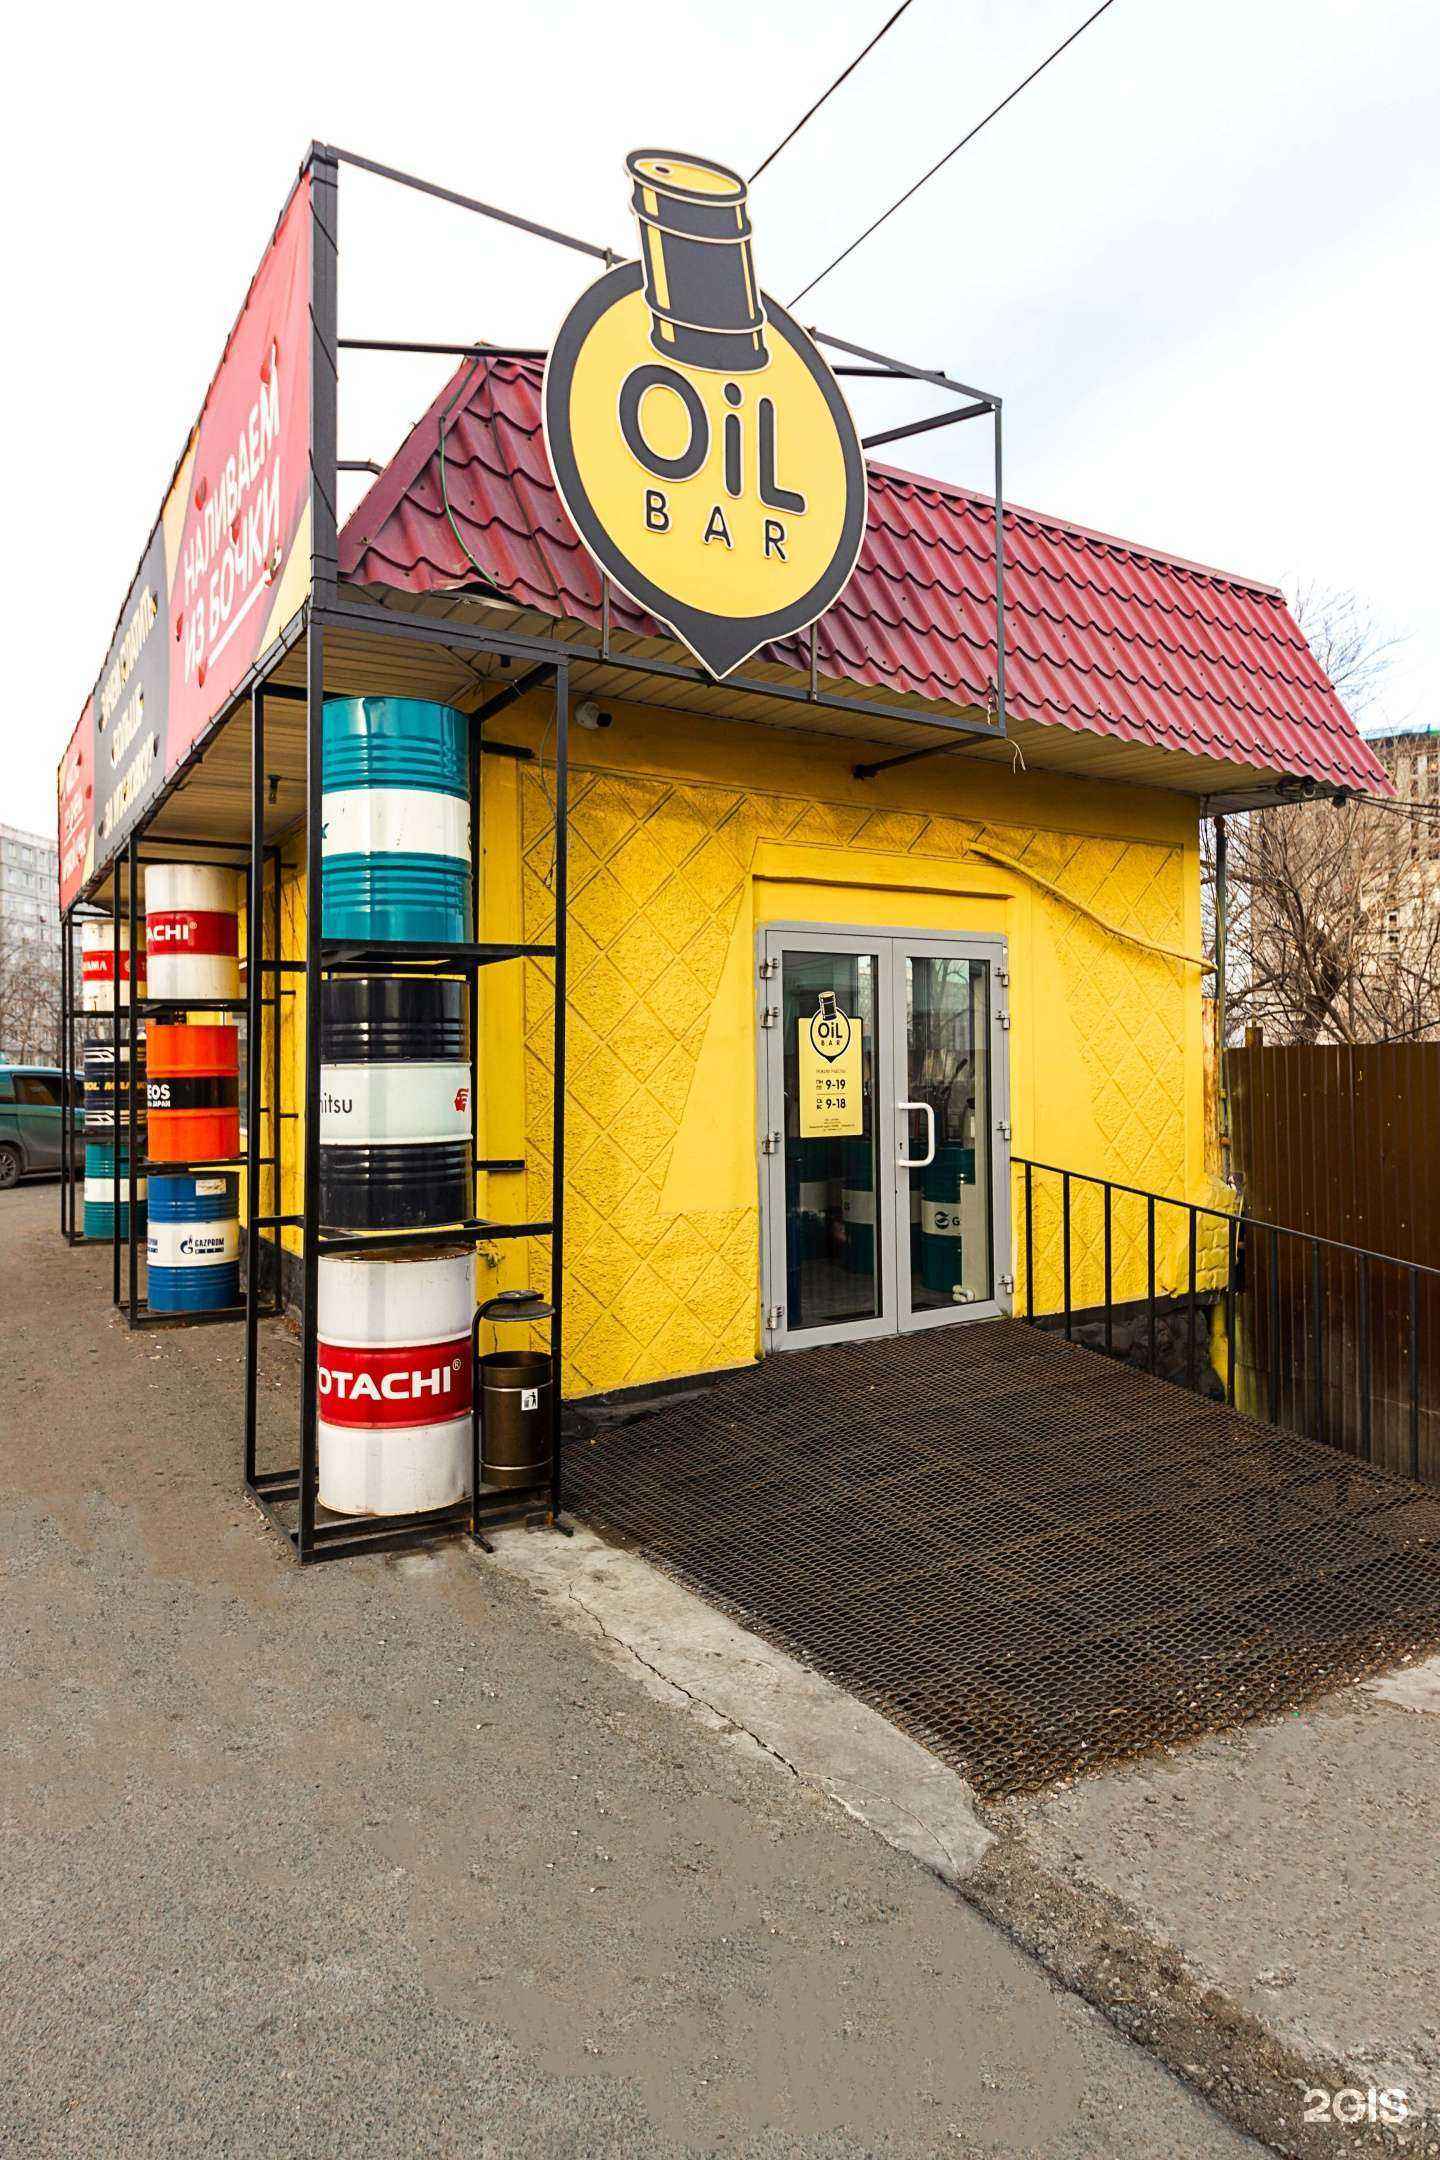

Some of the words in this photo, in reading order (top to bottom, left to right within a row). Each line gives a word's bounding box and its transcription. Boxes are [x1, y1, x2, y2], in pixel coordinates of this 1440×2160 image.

[183, 344, 280, 606] НАЛИВАЕМ
[644, 488, 789, 563] BAR
[184, 597, 206, 684] ИЗ
[209, 454, 280, 643] БОЧКИ
[146, 924, 189, 942] ACHI
[147, 1084, 171, 1101] EOS
[825, 1079, 846, 1090] 9-19
[825, 1098, 846, 1109] 9-18
[195, 1238, 225, 1248] GAZPROM
[318, 1365, 451, 1401] OTACHI
